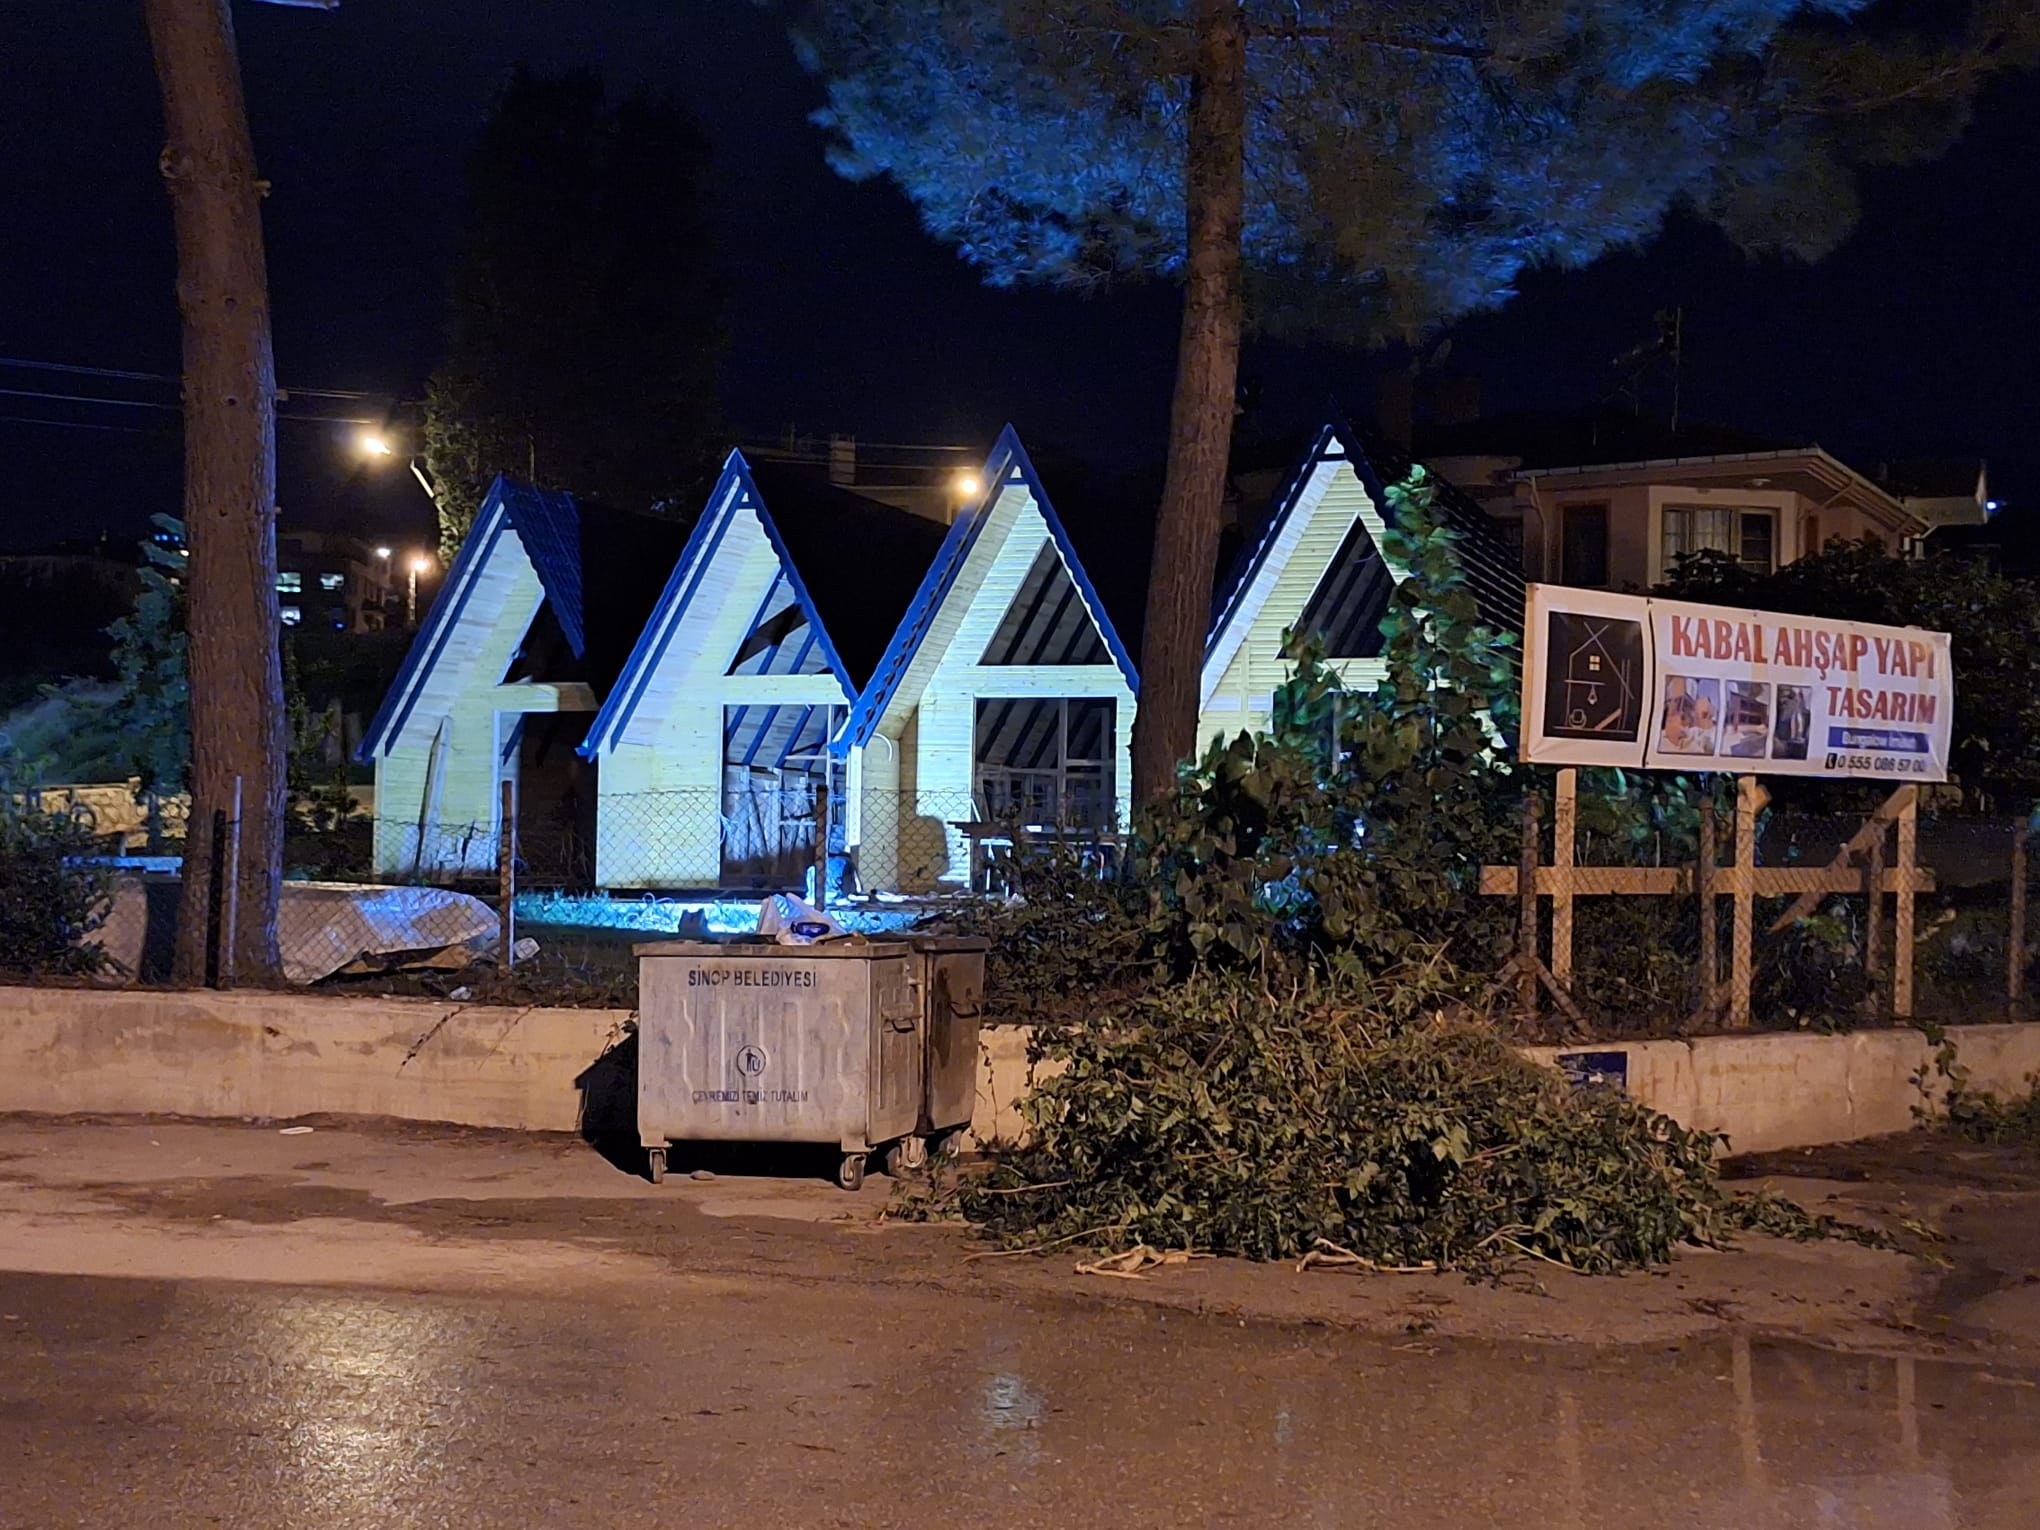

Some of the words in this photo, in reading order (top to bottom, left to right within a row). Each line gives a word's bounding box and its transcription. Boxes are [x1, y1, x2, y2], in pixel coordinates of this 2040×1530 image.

[1671, 615, 1768, 665] KABAL
[1774, 627, 1868, 680] AHŞAP
[1873, 637, 1935, 679] YAPI
[1826, 686, 1937, 724] TASARIM
[1837, 755, 1846, 768] 0
[1848, 756, 1872, 769] 555
[688, 964, 730, 986] SİNOP
[734, 964, 816, 987] BELEDİYESİ
